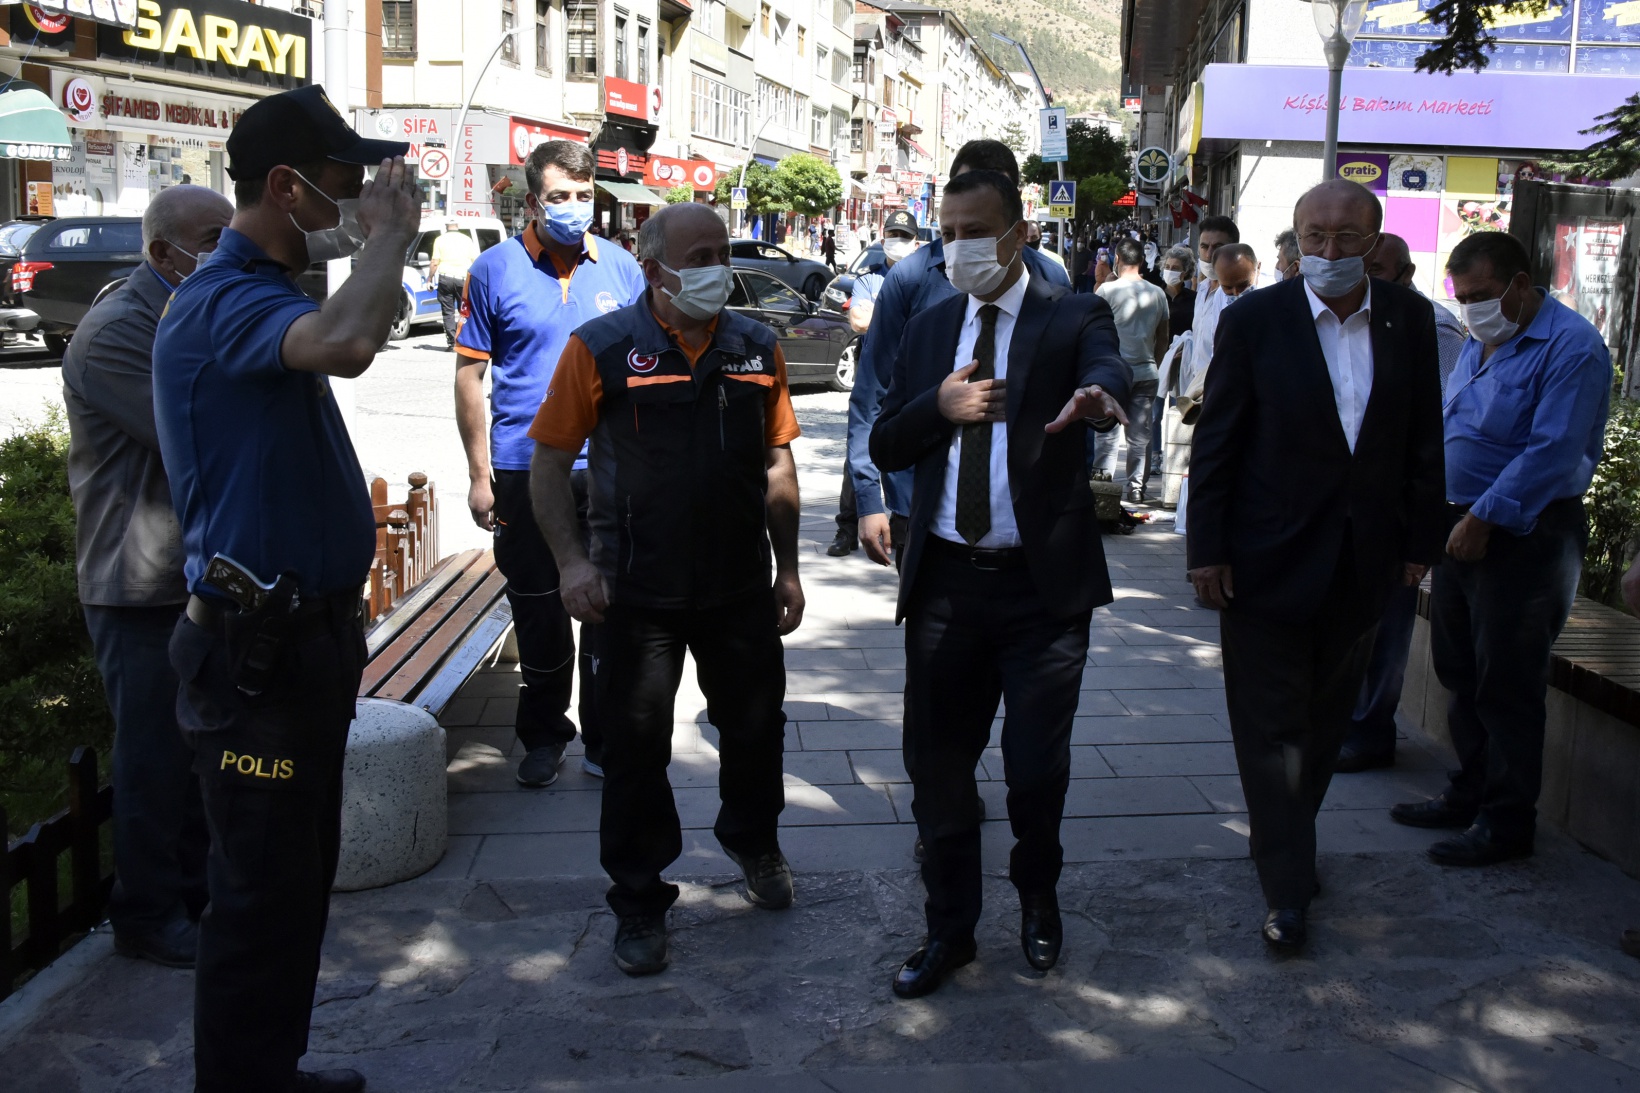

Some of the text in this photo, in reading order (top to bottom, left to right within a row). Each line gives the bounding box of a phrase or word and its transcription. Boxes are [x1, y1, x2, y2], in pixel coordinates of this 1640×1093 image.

[123, 0, 306, 78] SARAYI
[1282, 93, 1495, 116] Kişisl Bakım Marketi
[221, 110, 229, 129] &
[403, 115, 438, 137] ŞİFA
[6, 143, 55, 159] GÖNÜL
[53, 165, 85, 175] EKNOLOJİ
[464, 126, 473, 201] ECZANE
[1343, 164, 1377, 177] gratis
